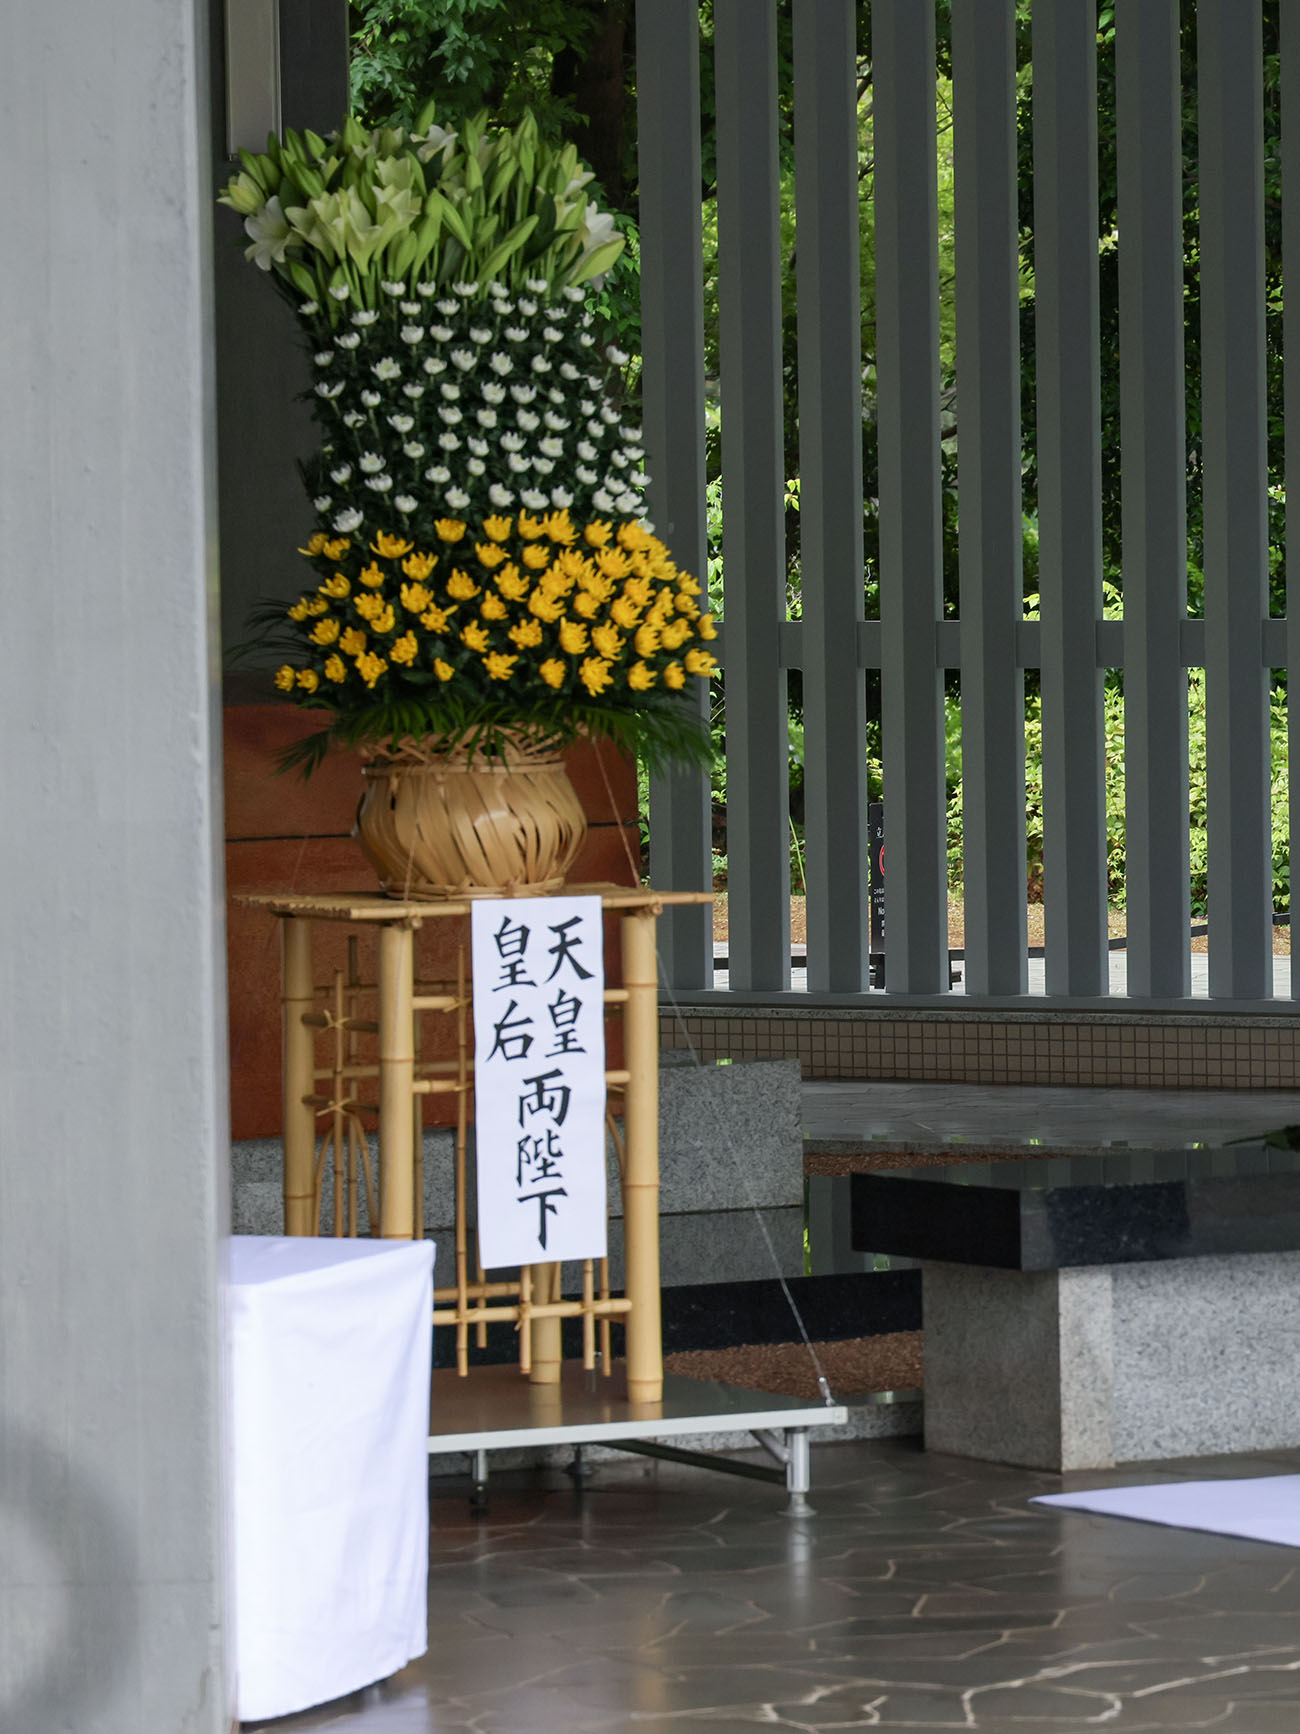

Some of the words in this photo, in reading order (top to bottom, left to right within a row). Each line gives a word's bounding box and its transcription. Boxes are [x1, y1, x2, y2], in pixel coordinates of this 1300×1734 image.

[486, 916, 538, 1062] 皇后
[543, 915, 595, 1059] 天皇
[516, 1068, 572, 1251] 両陛下
